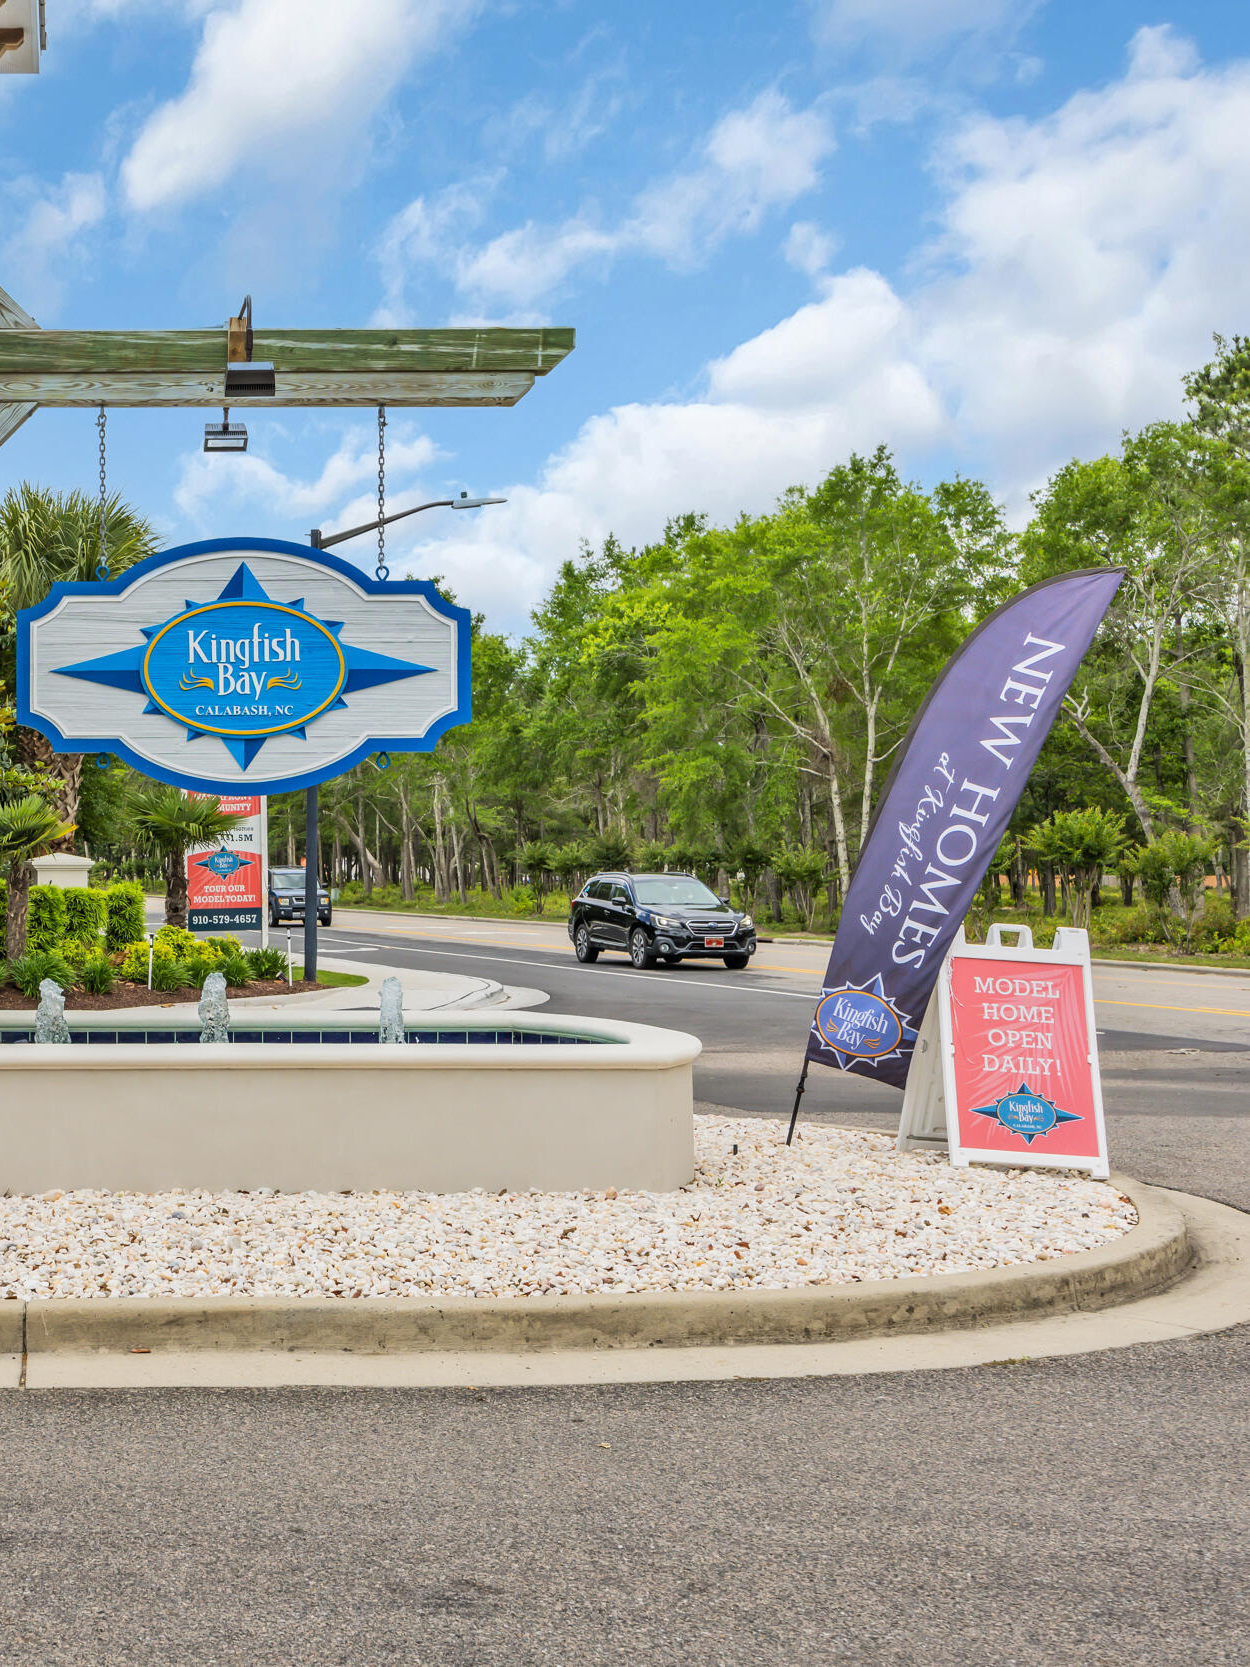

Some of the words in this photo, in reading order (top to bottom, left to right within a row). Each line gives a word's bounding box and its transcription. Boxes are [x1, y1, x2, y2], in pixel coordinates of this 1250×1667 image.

[187, 622, 301, 669] Kingfish
[217, 662, 267, 701] Bay
[195, 704, 272, 717] CALABASH,
[275, 704, 294, 715] NC
[979, 631, 1066, 770] NEW
[934, 752, 955, 794] at
[891, 785, 944, 886] Kingfish
[891, 777, 1001, 969] HOMES
[193, 895, 225, 904] MODEL
[225, 894, 256, 903] TODAY!
[204, 885, 227, 893] TOUR
[228, 884, 246, 892] OUR
[192, 914, 257, 925] 910-579-4657
[860, 884, 902, 936] Bay
[973, 976, 1060, 999] MODEL
[832, 997, 889, 1035] Kingfish
[982, 1002, 1055, 1024] HOME
[836, 1021, 867, 1050] Bay
[988, 1028, 1053, 1050] OPEN
[981, 1054, 1062, 1076] DAILY!
[1009, 1100, 1044, 1114] Kingfish
[1018, 1111, 1034, 1124] Bay
